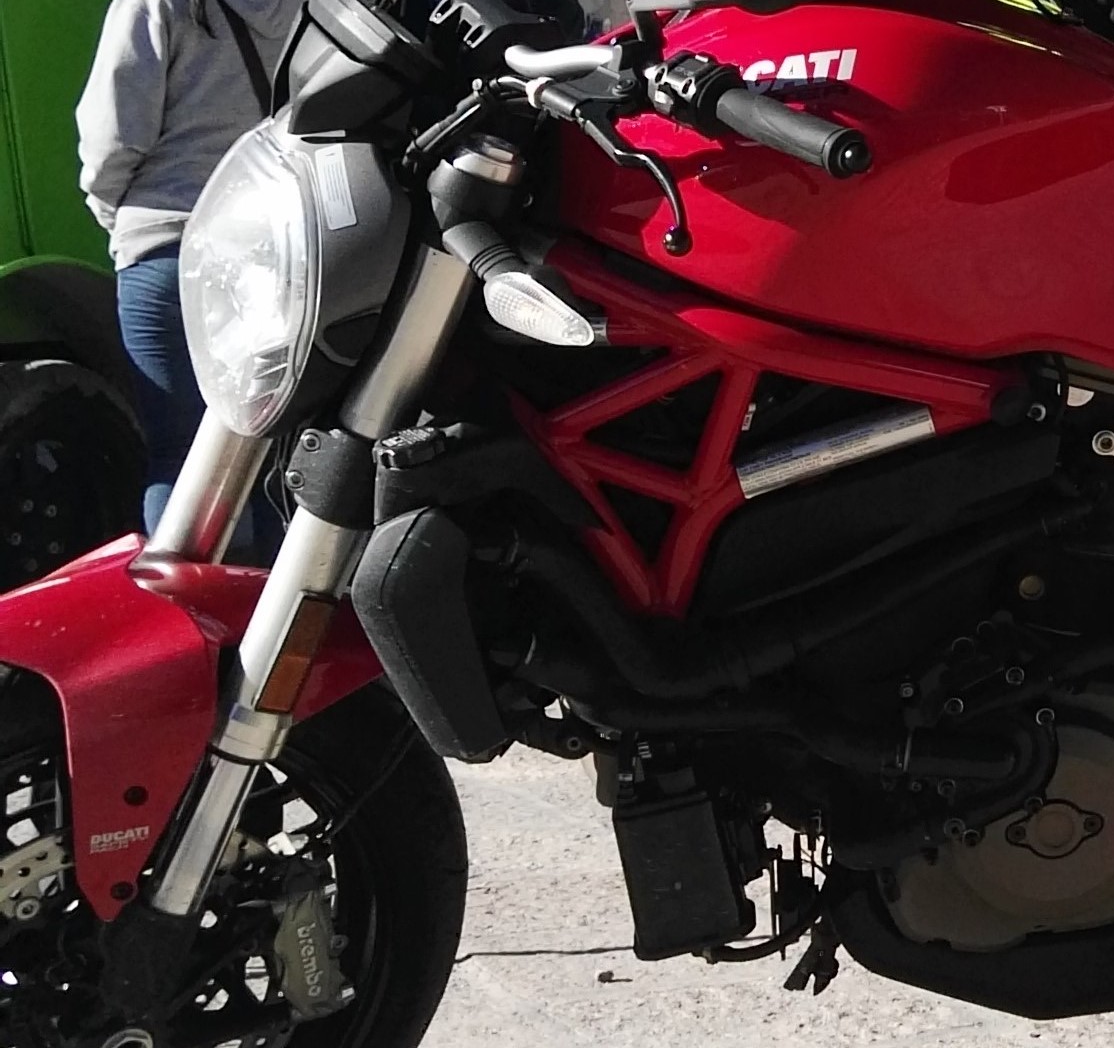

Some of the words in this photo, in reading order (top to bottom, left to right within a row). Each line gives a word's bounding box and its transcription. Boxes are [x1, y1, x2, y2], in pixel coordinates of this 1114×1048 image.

[742, 48, 858, 95] CATI
[90, 825, 149, 846] DUCATI
[297, 922, 324, 997] brembo
